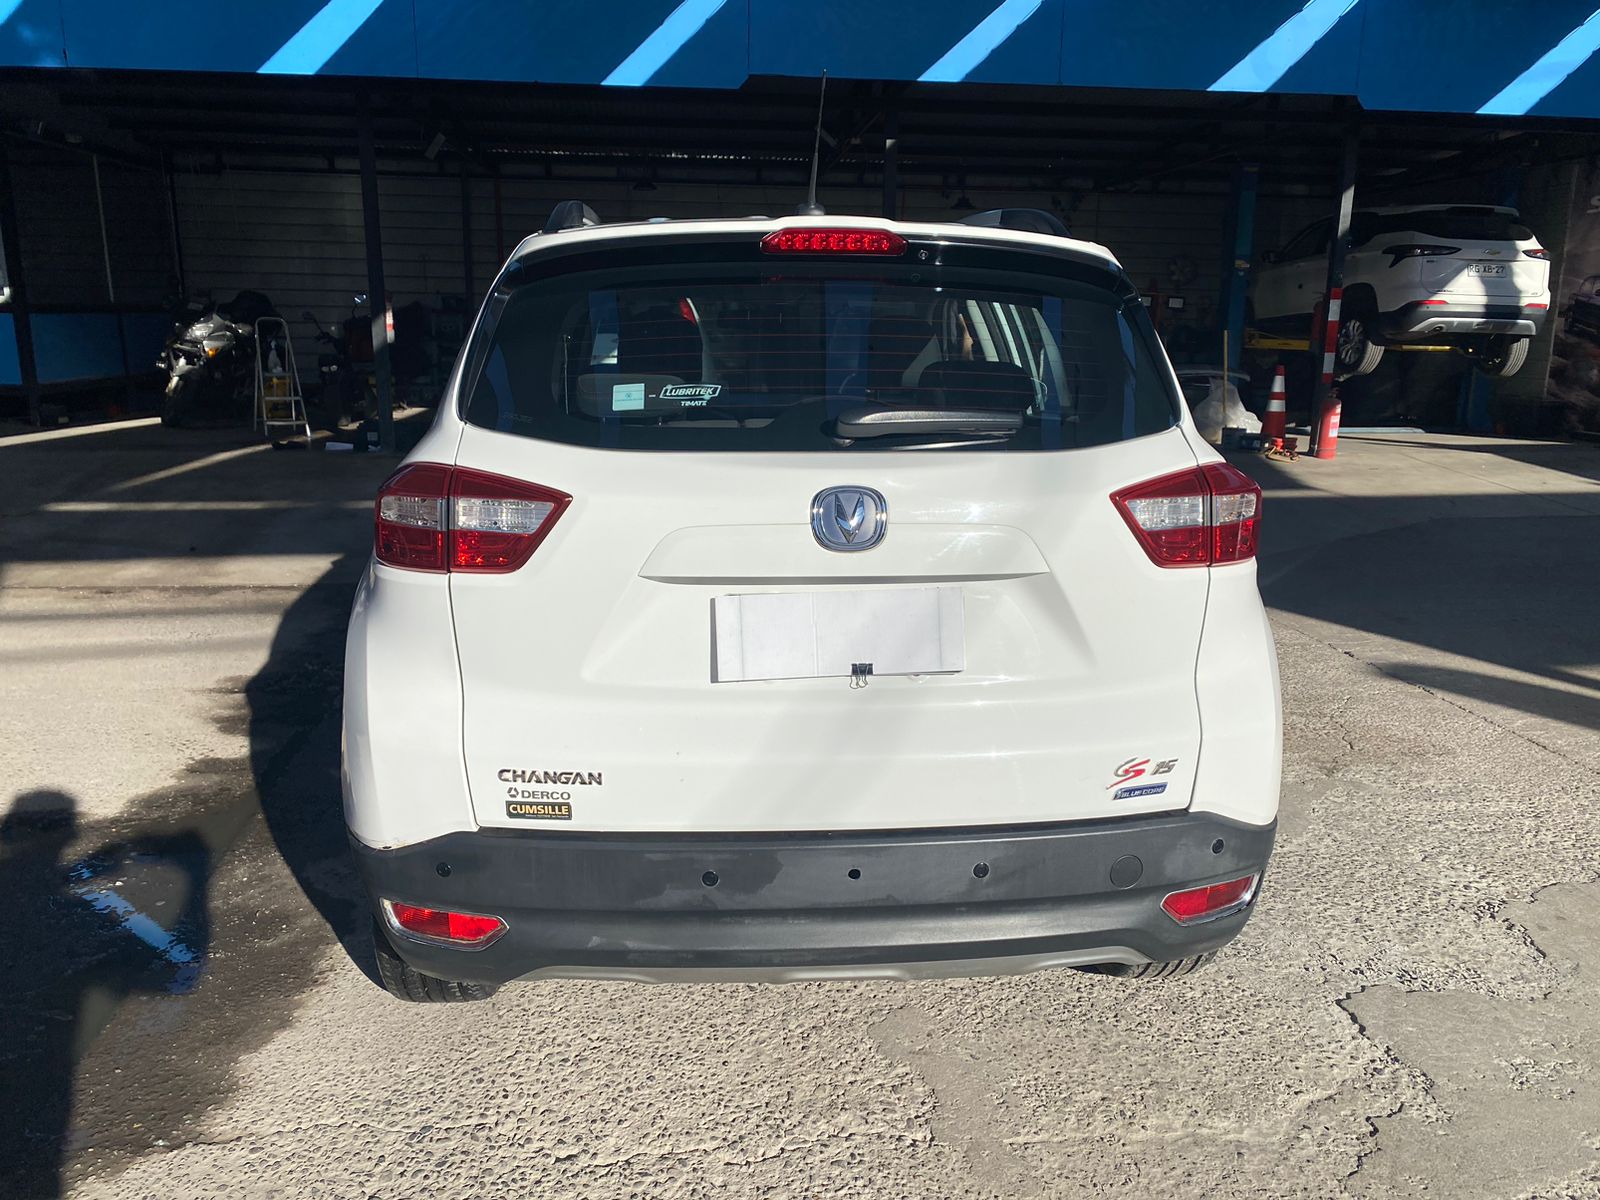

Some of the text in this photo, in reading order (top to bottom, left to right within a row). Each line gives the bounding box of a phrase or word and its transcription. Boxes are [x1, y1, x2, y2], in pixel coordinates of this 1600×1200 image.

[666, 387, 714, 396] LUBRITEK
[1150, 758, 1179, 776] 15
[497, 768, 603, 785] CHANGAN
[520, 789, 571, 801] DERCO
[509, 804, 569, 815] CUMSILLE
